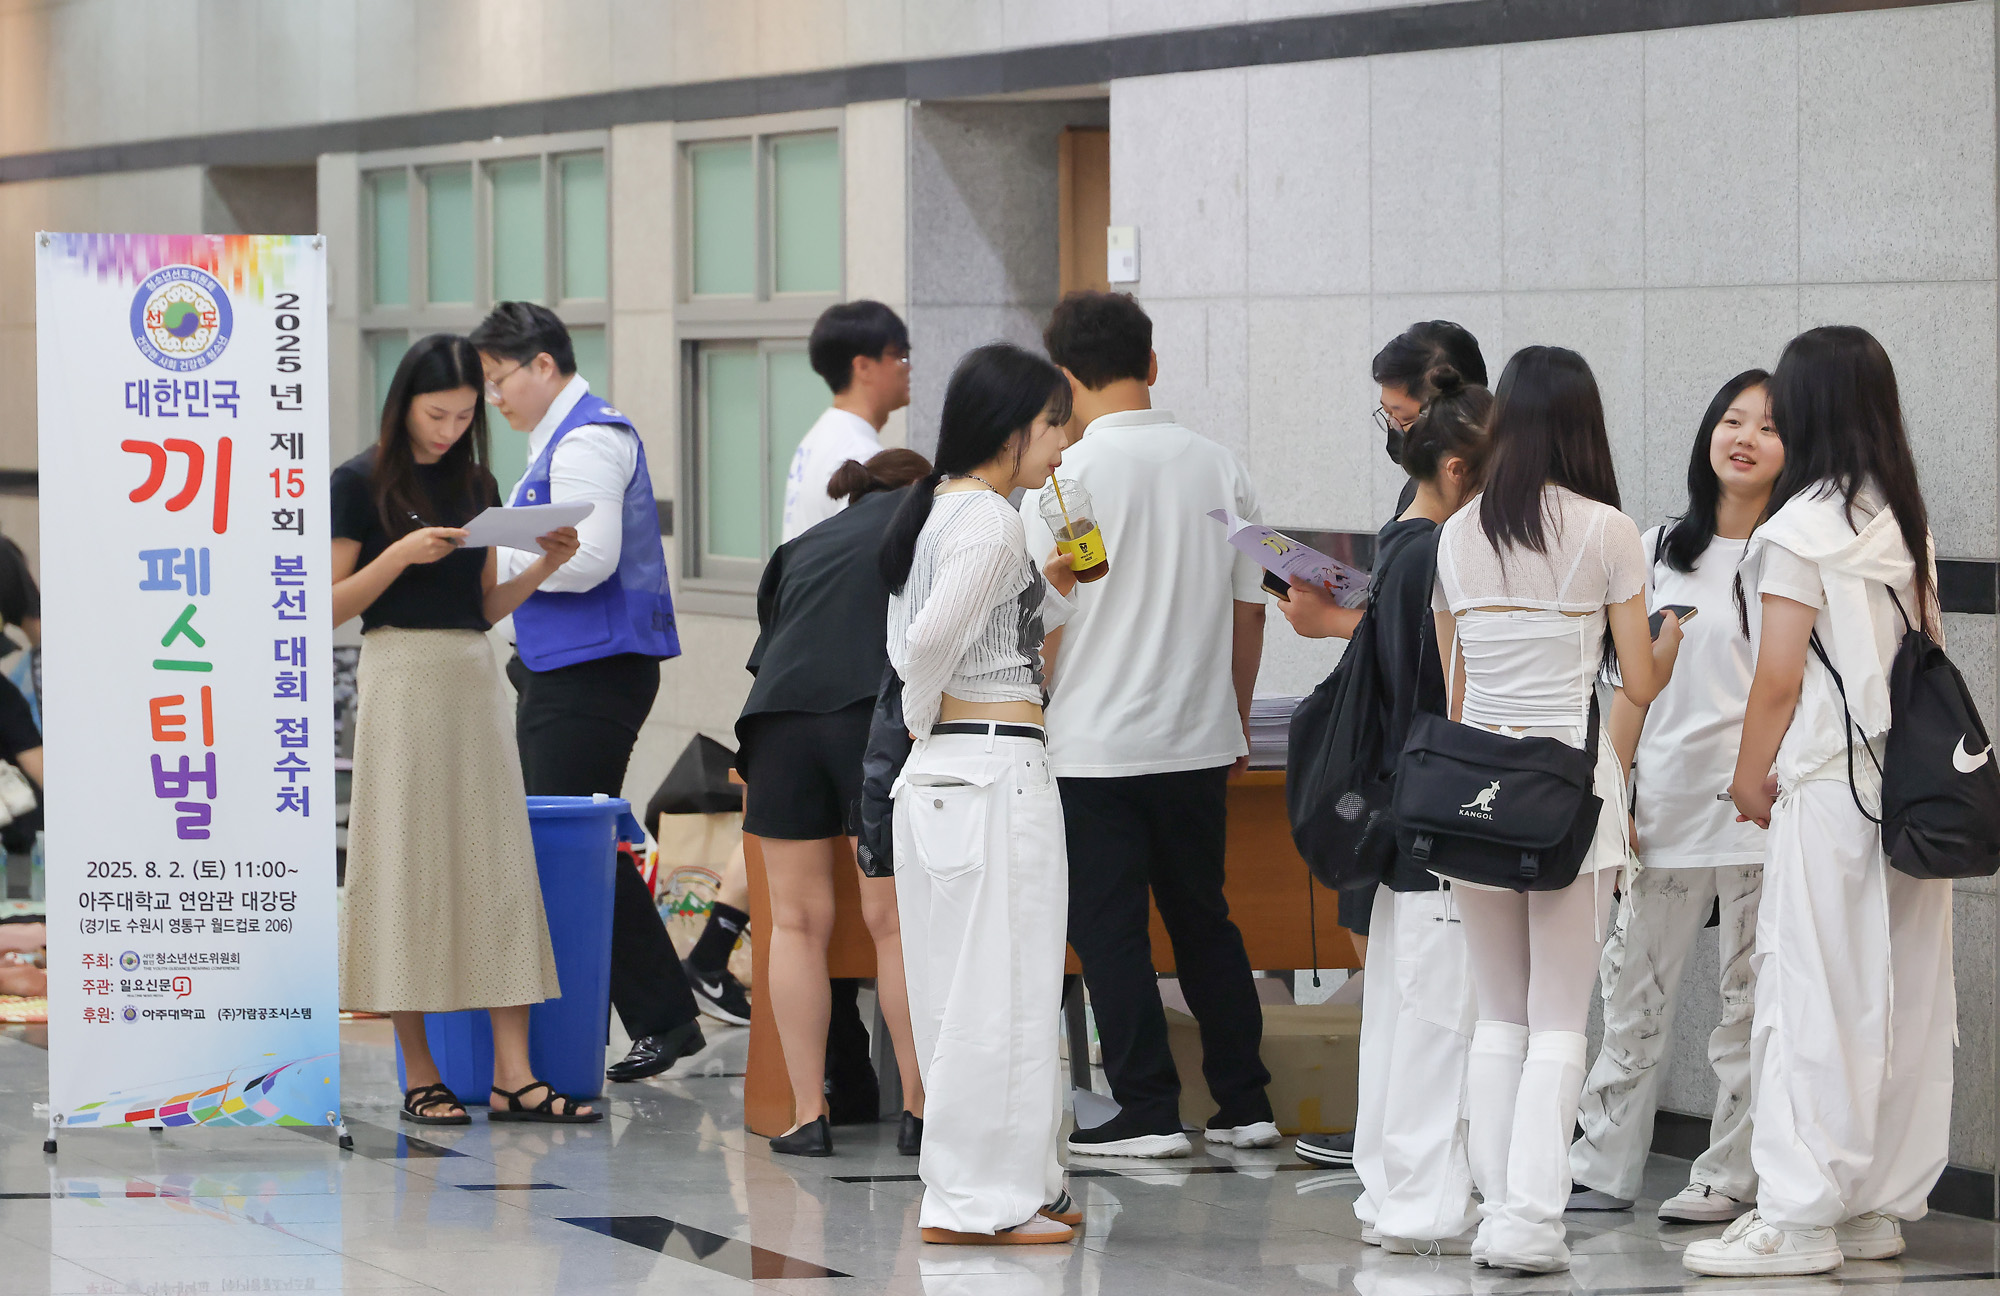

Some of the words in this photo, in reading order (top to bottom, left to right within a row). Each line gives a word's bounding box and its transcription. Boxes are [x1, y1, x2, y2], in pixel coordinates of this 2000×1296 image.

[146, 310, 161, 329] 선
[271, 294, 302, 410] 2025년
[125, 379, 240, 418] 대한민국
[121, 437, 232, 534] 끼
[270, 433, 304, 535] 제15회
[271, 556, 307, 620] 본선
[274, 637, 307, 702] 대회
[139, 548, 217, 840] 페스티벌
[274, 717, 310, 817] 접수처
[1458, 809, 1493, 820] KANGOL
[87, 862, 136, 878] 2025.
[146, 862, 160, 878] 8.
[170, 862, 184, 878] 2.
[193, 860, 225, 880] (토)
[235, 862, 298, 877] 11:00~
[79, 891, 171, 911] 아주대학교
[179, 891, 234, 911] 연암관
[242, 891, 297, 911] 대강당
[80, 918, 121, 934] (경기도
[127, 918, 163, 933] 수원시
[169, 919, 205, 933] 영통구
[211, 918, 260, 933] 월드컵로
[266, 918, 292, 933] 206)
[82, 954, 113, 969] 주최:
[156, 953, 239, 964] 청소년선도위원회
[83, 979, 114, 995] 주관:
[121, 979, 171, 992] 일요신문
[83, 1007, 115, 1023] 후원:
[142, 1009, 205, 1020] 아주대학교
[218, 1008, 311, 1021] (주)가람공조시스템
